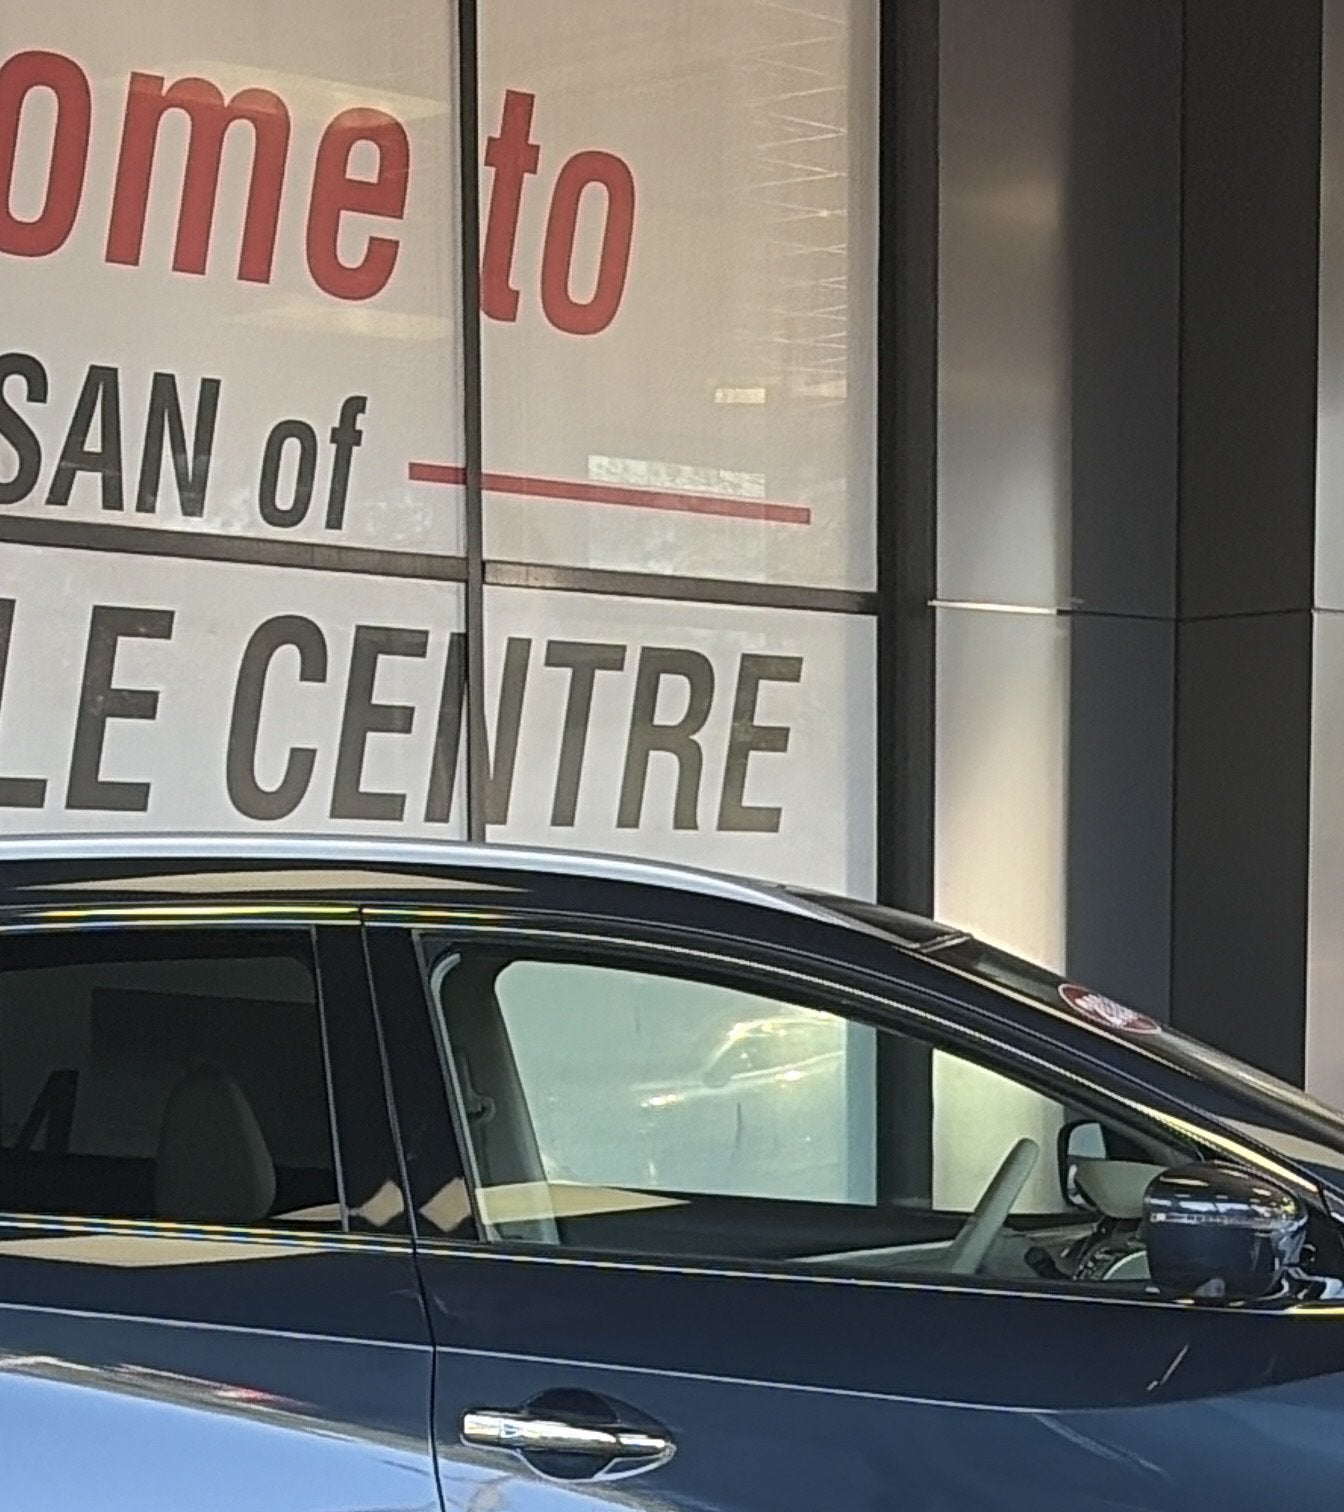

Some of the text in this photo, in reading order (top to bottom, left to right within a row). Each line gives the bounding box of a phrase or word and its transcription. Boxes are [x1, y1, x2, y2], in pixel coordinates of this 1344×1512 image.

[479, 89, 635, 335] to
[256, 395, 367, 531] of
[224, 614, 804, 834] CENTRE
